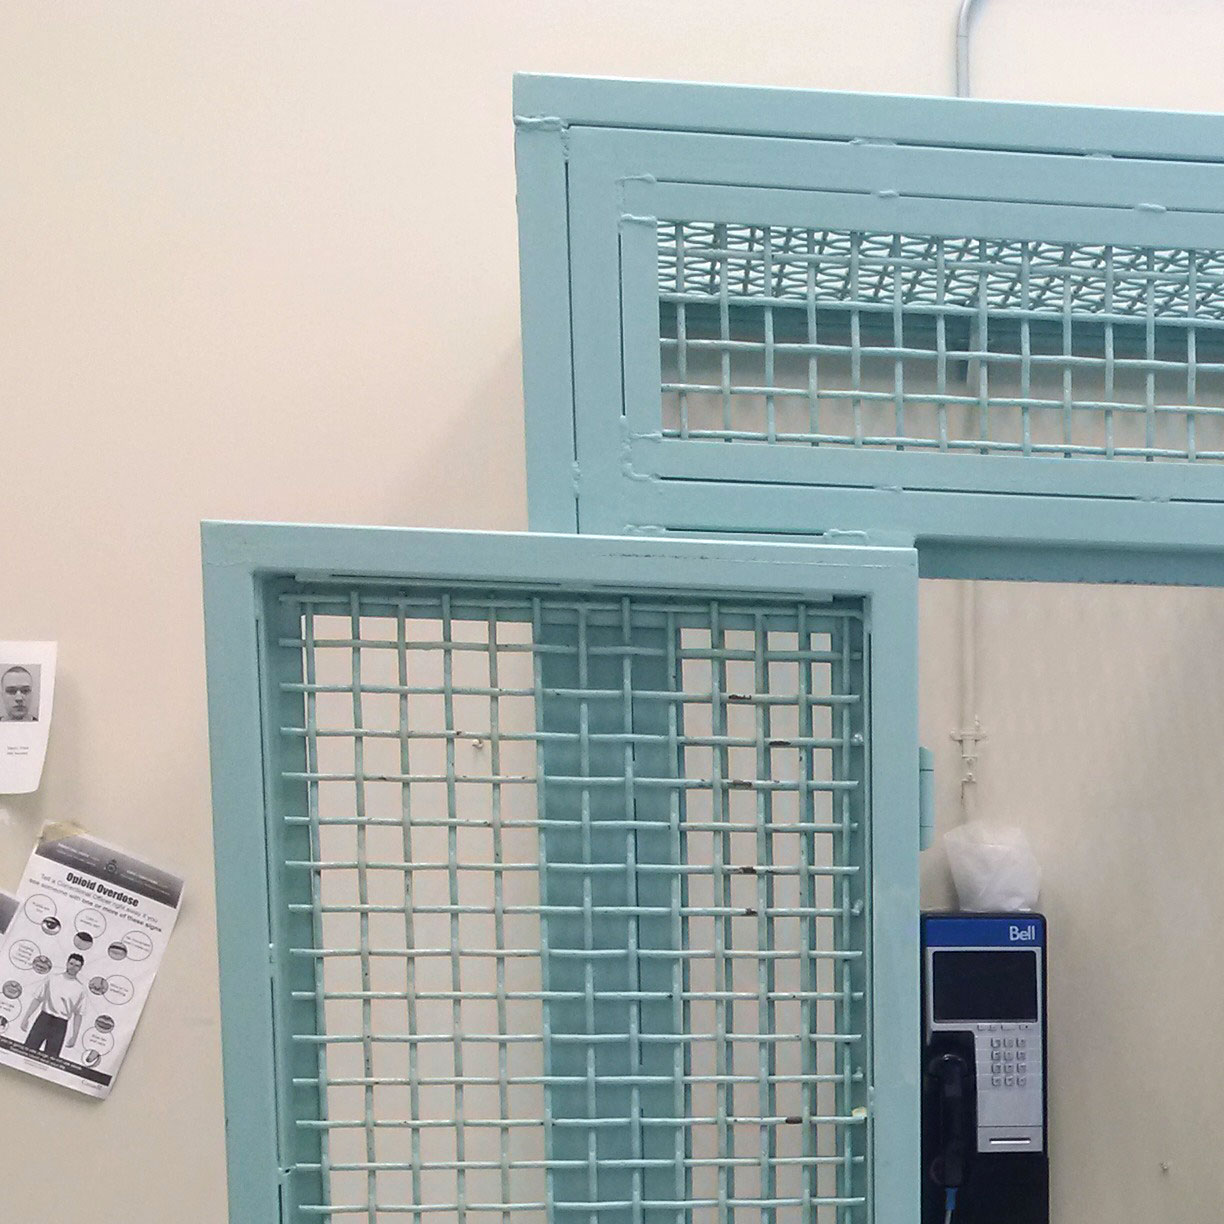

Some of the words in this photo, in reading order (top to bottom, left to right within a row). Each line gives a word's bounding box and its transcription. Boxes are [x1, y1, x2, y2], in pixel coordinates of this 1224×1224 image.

[66, 872, 96, 890] Opioid
[97, 884, 139, 907] Overdose
[82, 898, 93, 906] one
[103, 906, 118, 916] more
[127, 915, 144, 925] these
[93, 894, 111, 905] Officer
[112, 902, 126, 910] right
[126, 908, 141, 917] away
[1009, 925, 1036, 941] Bell
